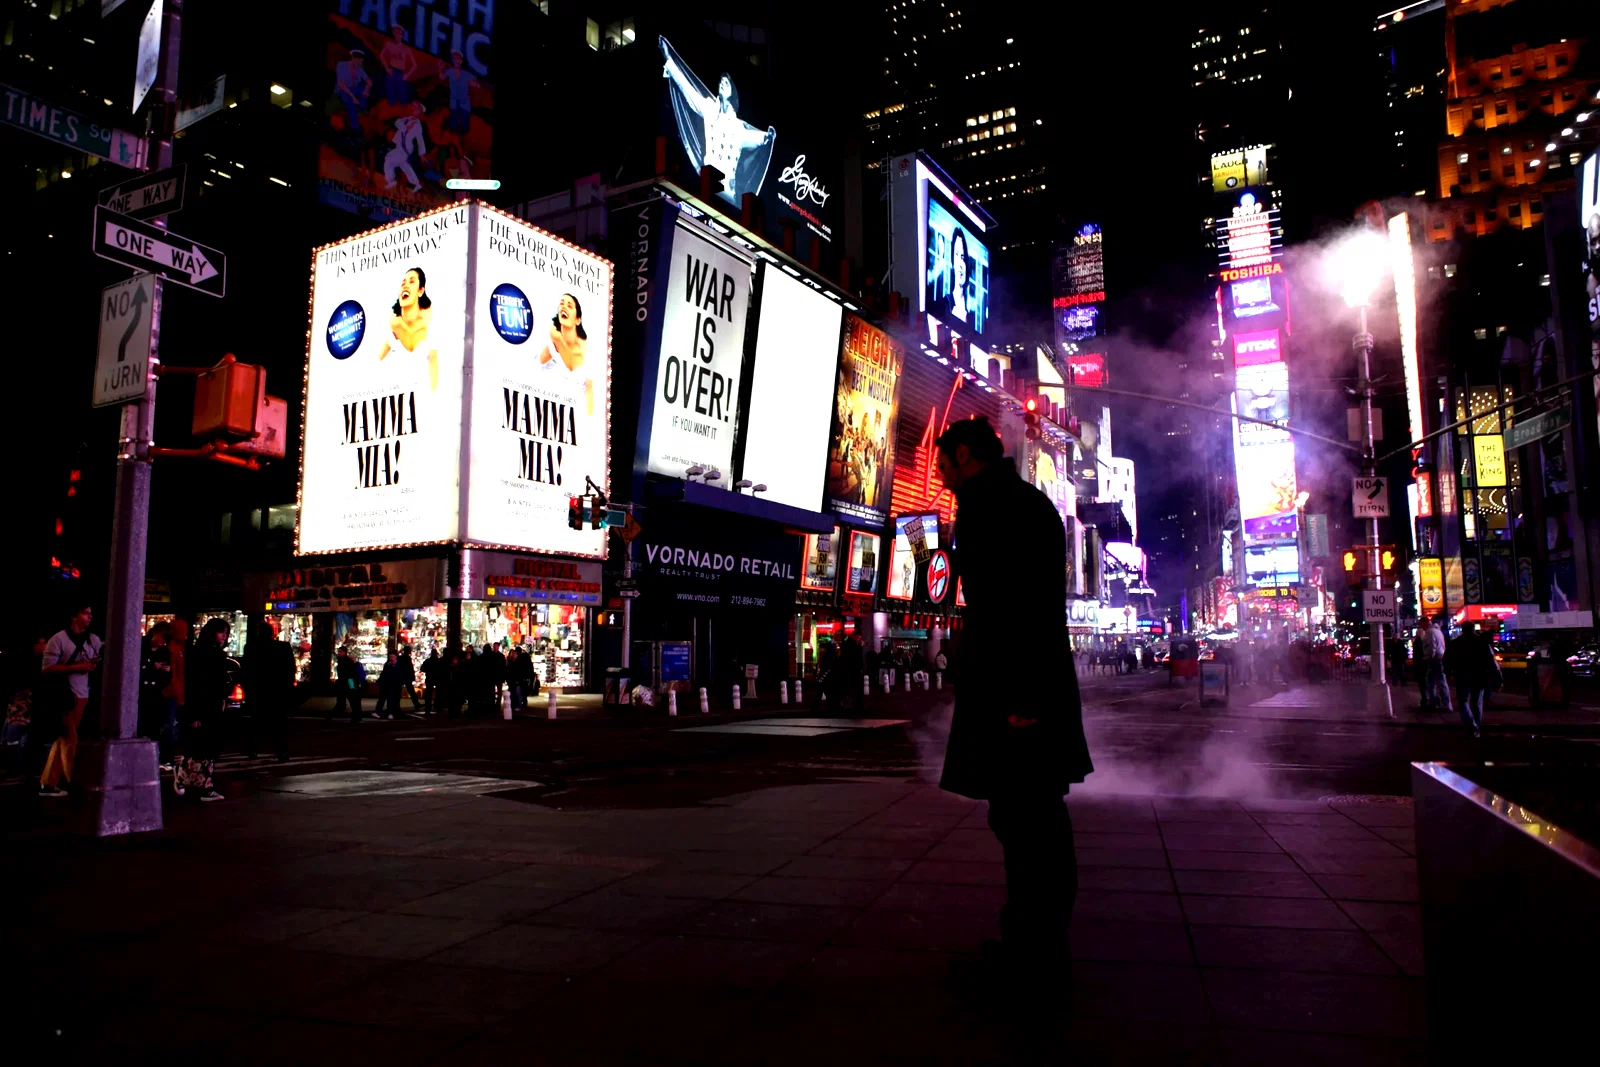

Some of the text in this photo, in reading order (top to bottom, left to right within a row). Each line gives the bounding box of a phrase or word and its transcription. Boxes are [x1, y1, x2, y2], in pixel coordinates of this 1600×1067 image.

[5, 91, 112, 143] TIMES SQ
[109, 181, 172, 213] ONE WAY
[351, 228, 410, 257] FEEL-GOOD
[415, 208, 467, 237] MUSICAL
[1229, 214, 1267, 226] TOSHIBA
[116, 229, 207, 276] ONE WAY
[489, 236, 545, 272] POPULAR
[636, 206, 650, 322] VORNADO
[336, 265, 346, 278] IS
[572, 257, 601, 279] MOST
[1221, 263, 1283, 282] TOSHIBA
[685, 253, 736, 323] WAR
[106, 291, 130, 321] NO
[692, 311, 716, 364] IS
[849, 320, 904, 377] HEIGHTS
[1247, 339, 1277, 352] TDK
[663, 355, 733, 423] OVER!
[852, 370, 890, 405] BEST MUSICAL
[341, 391, 418, 446] MAMMA
[502, 387, 577, 446] MAMMA
[672, 415, 717, 441] IF YOU WANT IT
[1514, 415, 1561, 442] Broadway
[355, 440, 400, 490] MIA!
[518, 437, 562, 487] MIA!
[1479, 455, 1500, 466] LION
[1480, 468, 1502, 479] KING
[1356, 480, 1371, 489] NO
[514, 558, 581, 580] DIGITAL
[646, 543, 735, 572] VORNADO
[740, 557, 795, 580] RETAIL
[660, 567, 720, 580] REALTY TRUST
[277, 564, 387, 588] DIGITAL
[487, 575, 536, 588] CAMERAS
[548, 580, 600, 593] COMPUTERS
[677, 592, 720, 603] www.vno.com
[1372, 595, 1385, 604] NO
[1366, 608, 1393, 618] TURNS
